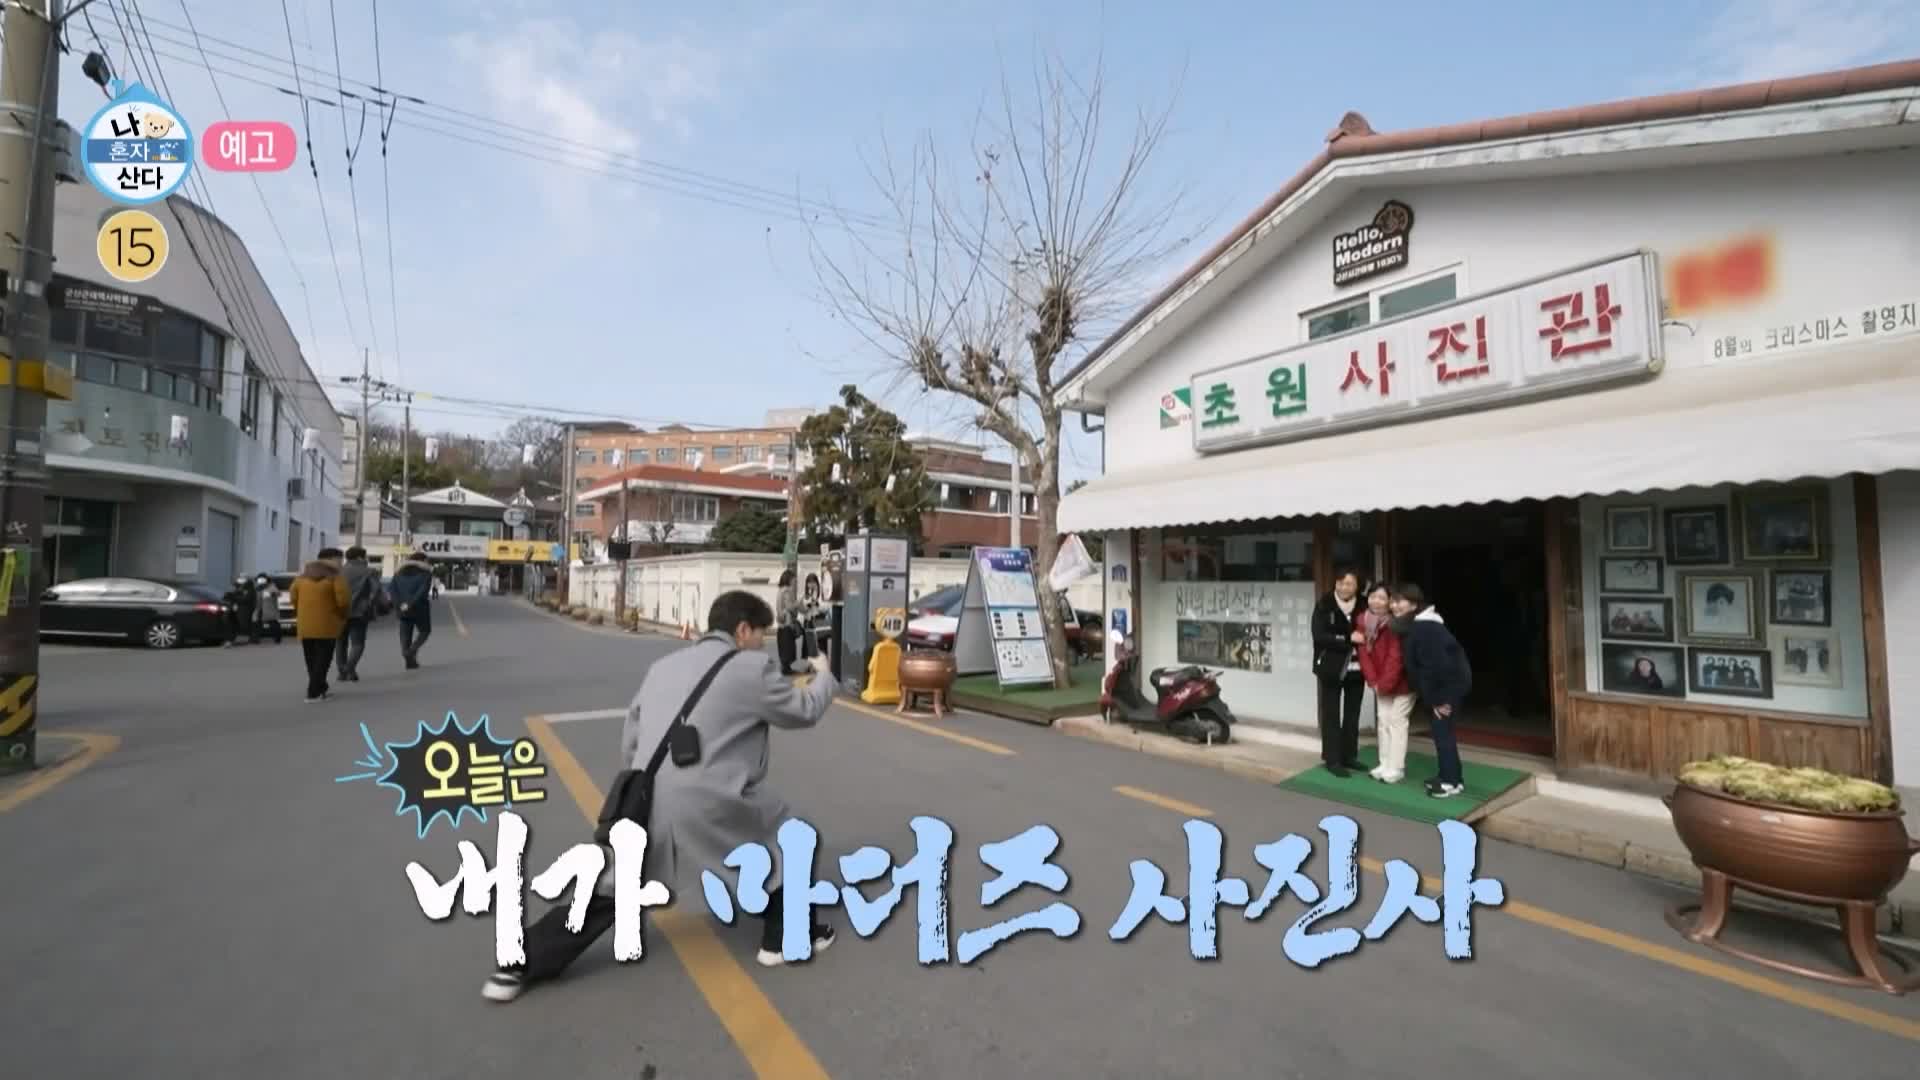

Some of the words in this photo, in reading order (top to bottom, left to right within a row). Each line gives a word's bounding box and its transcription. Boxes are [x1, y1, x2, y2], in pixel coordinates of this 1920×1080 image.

[1335, 228, 1384, 253] Hello,
[1335, 234, 1403, 268] Modern
[1713, 334, 1753, 358] 8월의
[1764, 316, 1849, 349] 크리스마스
[1861, 302, 1917, 335] 촬영지
